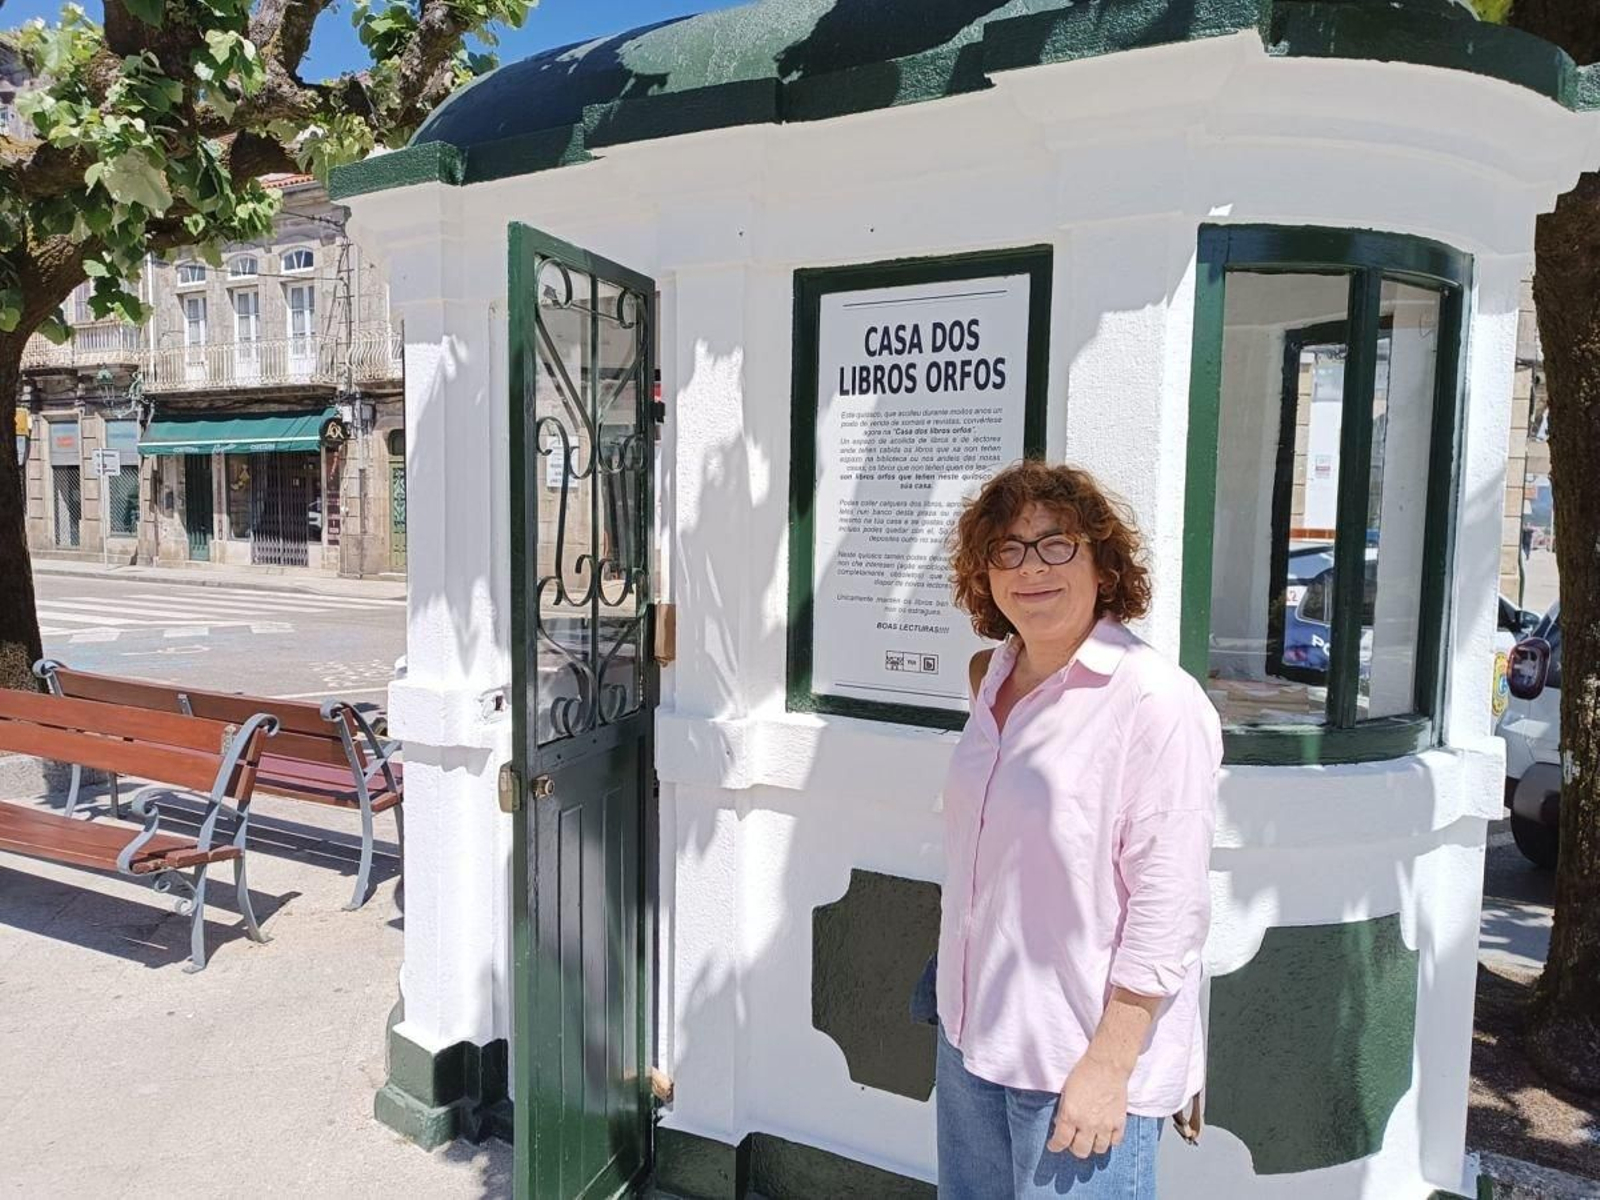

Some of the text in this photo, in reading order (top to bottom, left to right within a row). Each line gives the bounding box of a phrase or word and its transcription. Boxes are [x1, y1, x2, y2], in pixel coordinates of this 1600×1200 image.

[864, 318, 980, 357] CASA DOS
[839, 357, 1006, 397] LIBROS ORFOS
[884, 411, 897, 419] que
[914, 427, 928, 435] dos
[839, 499, 859, 507] Podes
[837, 568, 885, 577] completamente
[876, 621, 898, 630] BOAS
